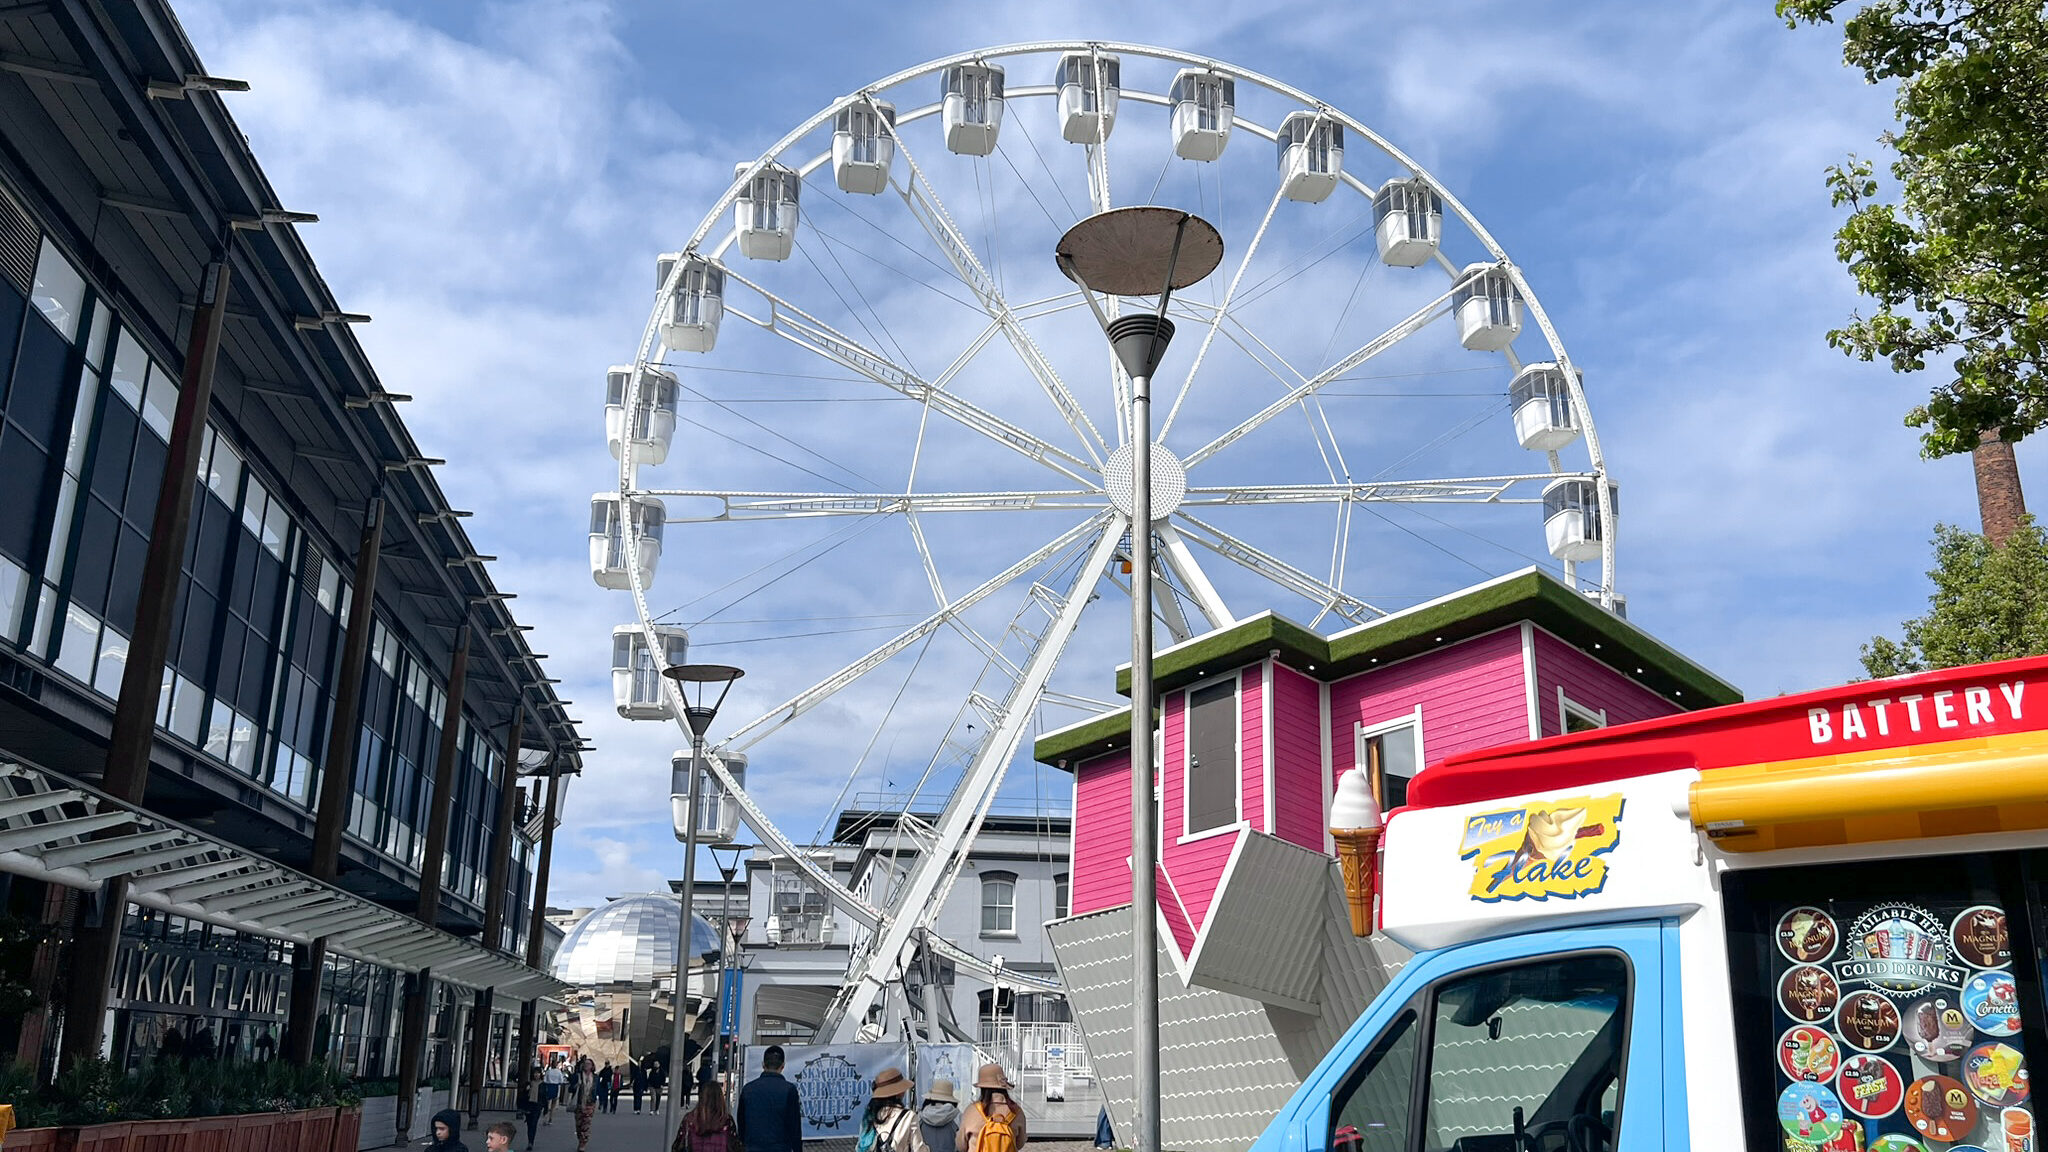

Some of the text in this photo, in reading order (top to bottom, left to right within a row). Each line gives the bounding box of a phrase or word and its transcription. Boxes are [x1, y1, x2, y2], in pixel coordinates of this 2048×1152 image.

[1807, 680, 2025, 744] BATTERY
[1469, 813, 1524, 838] Try a
[1482, 845, 1593, 893] Flake
[1853, 908, 1945, 951] AVAILABLE HERE
[119, 948, 288, 1015] IKKA FLAME
[1841, 962, 1960, 983] COLD DRINKS
[1788, 989, 1830, 999] MAGNUM
[1945, 1012, 1959, 1023] M
[1975, 1000, 2018, 1017] Cornetto
[1846, 1015, 1890, 1028] MAGNUM
[797, 1079, 874, 1098] SERVATION
[1853, 1078, 1887, 1099] FEAST
[1950, 1092, 1963, 1103] M
[801, 1098, 852, 1117] WHEEL
